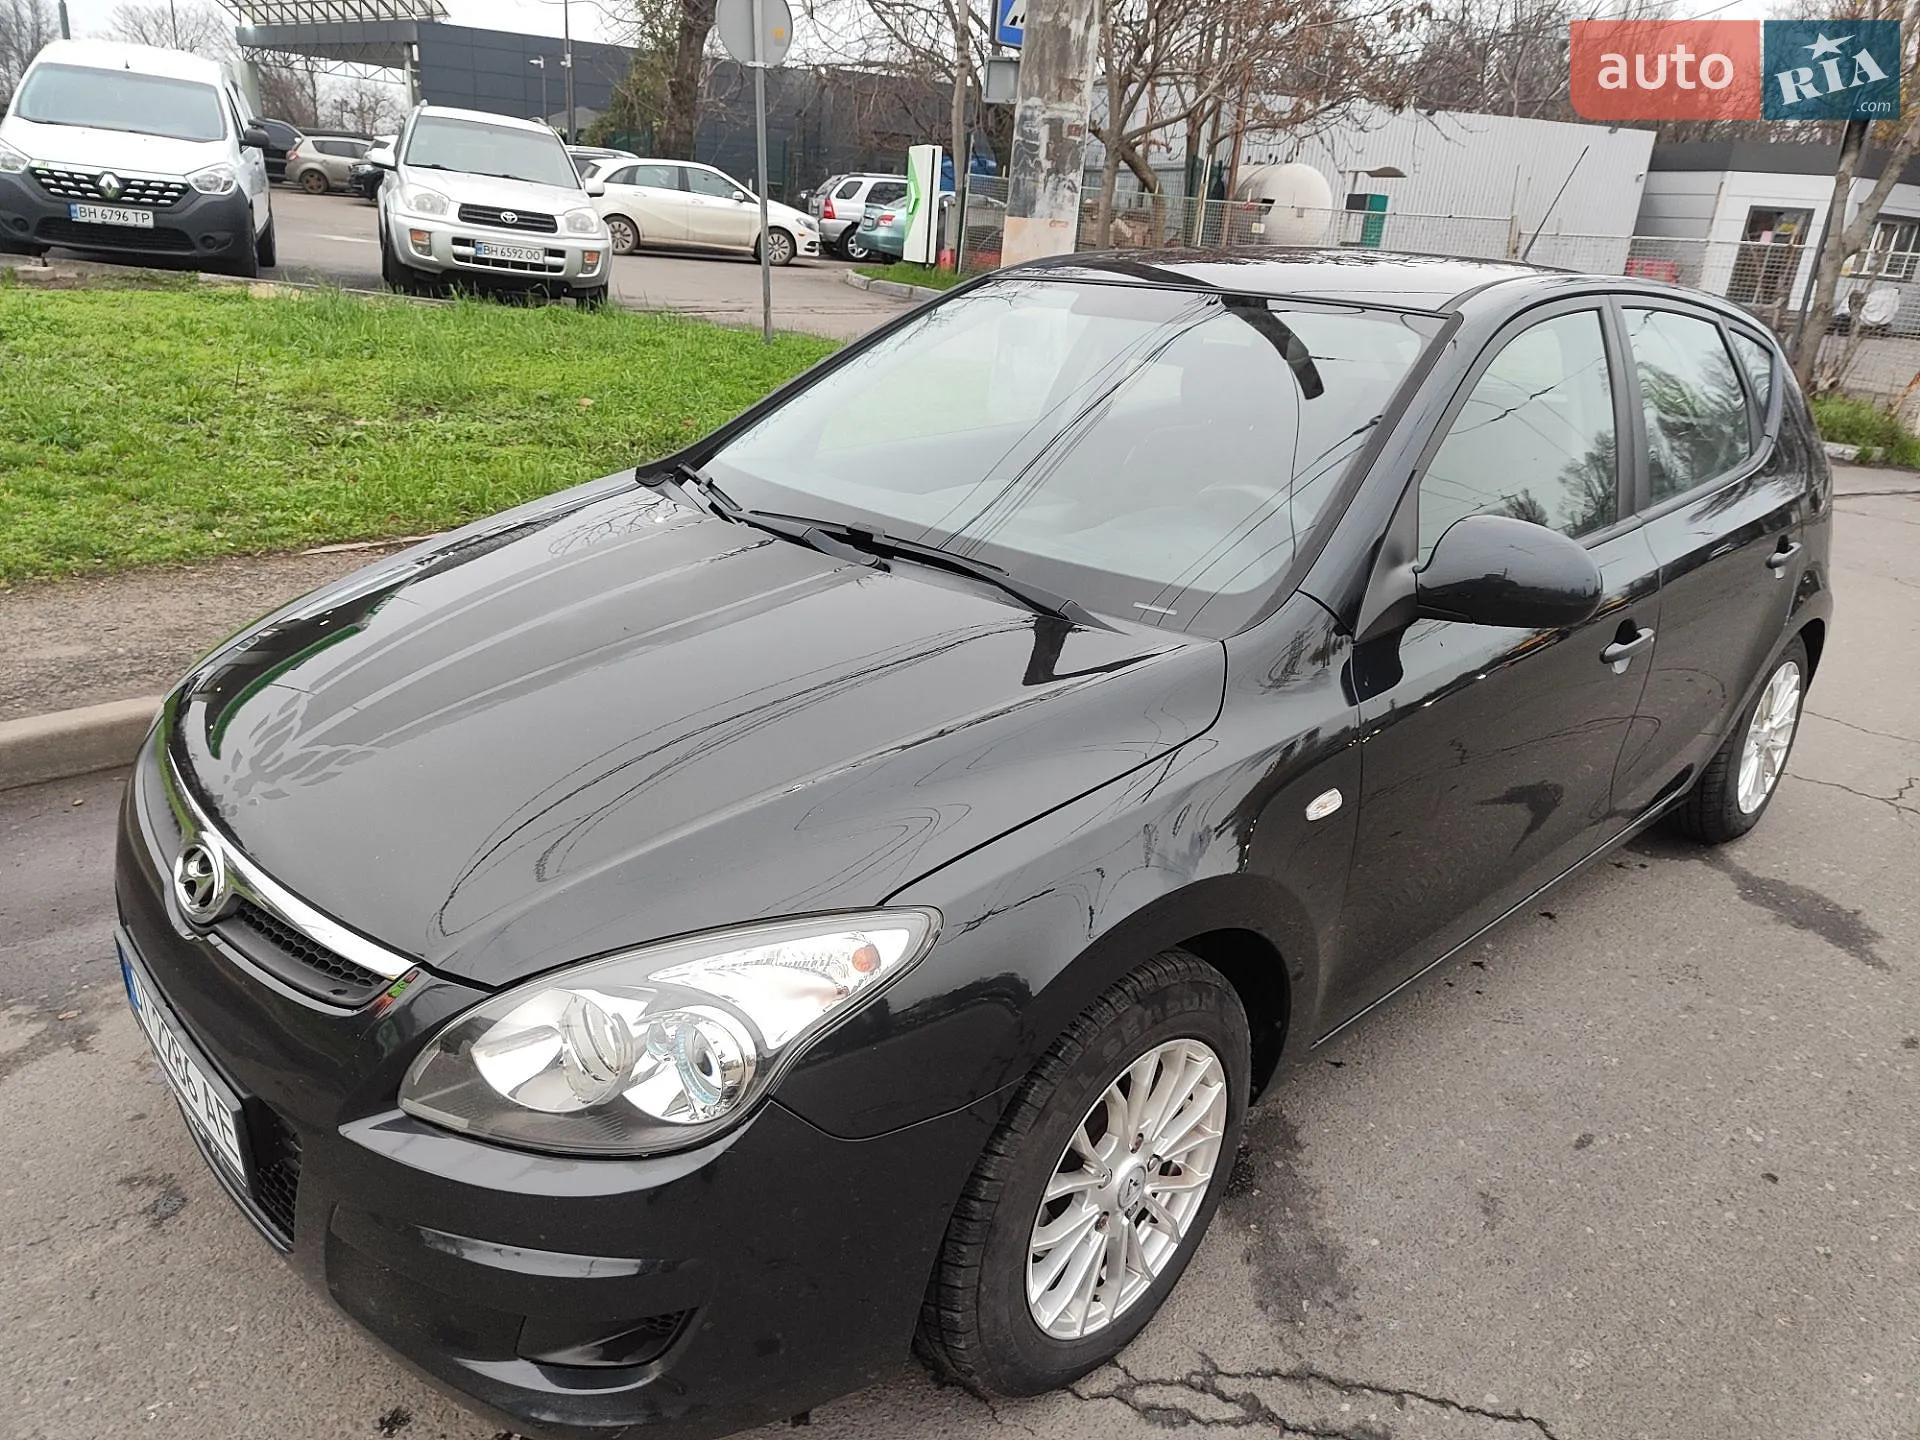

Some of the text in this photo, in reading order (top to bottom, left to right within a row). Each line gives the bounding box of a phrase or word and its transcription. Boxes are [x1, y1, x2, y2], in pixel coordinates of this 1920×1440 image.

[79, 206, 150, 223] BH 6796 TP
[483, 245, 498, 256] BH
[500, 247, 523, 258] 6592
[151, 1006, 199, 1104] 2286
[203, 1080, 240, 1162] AE
